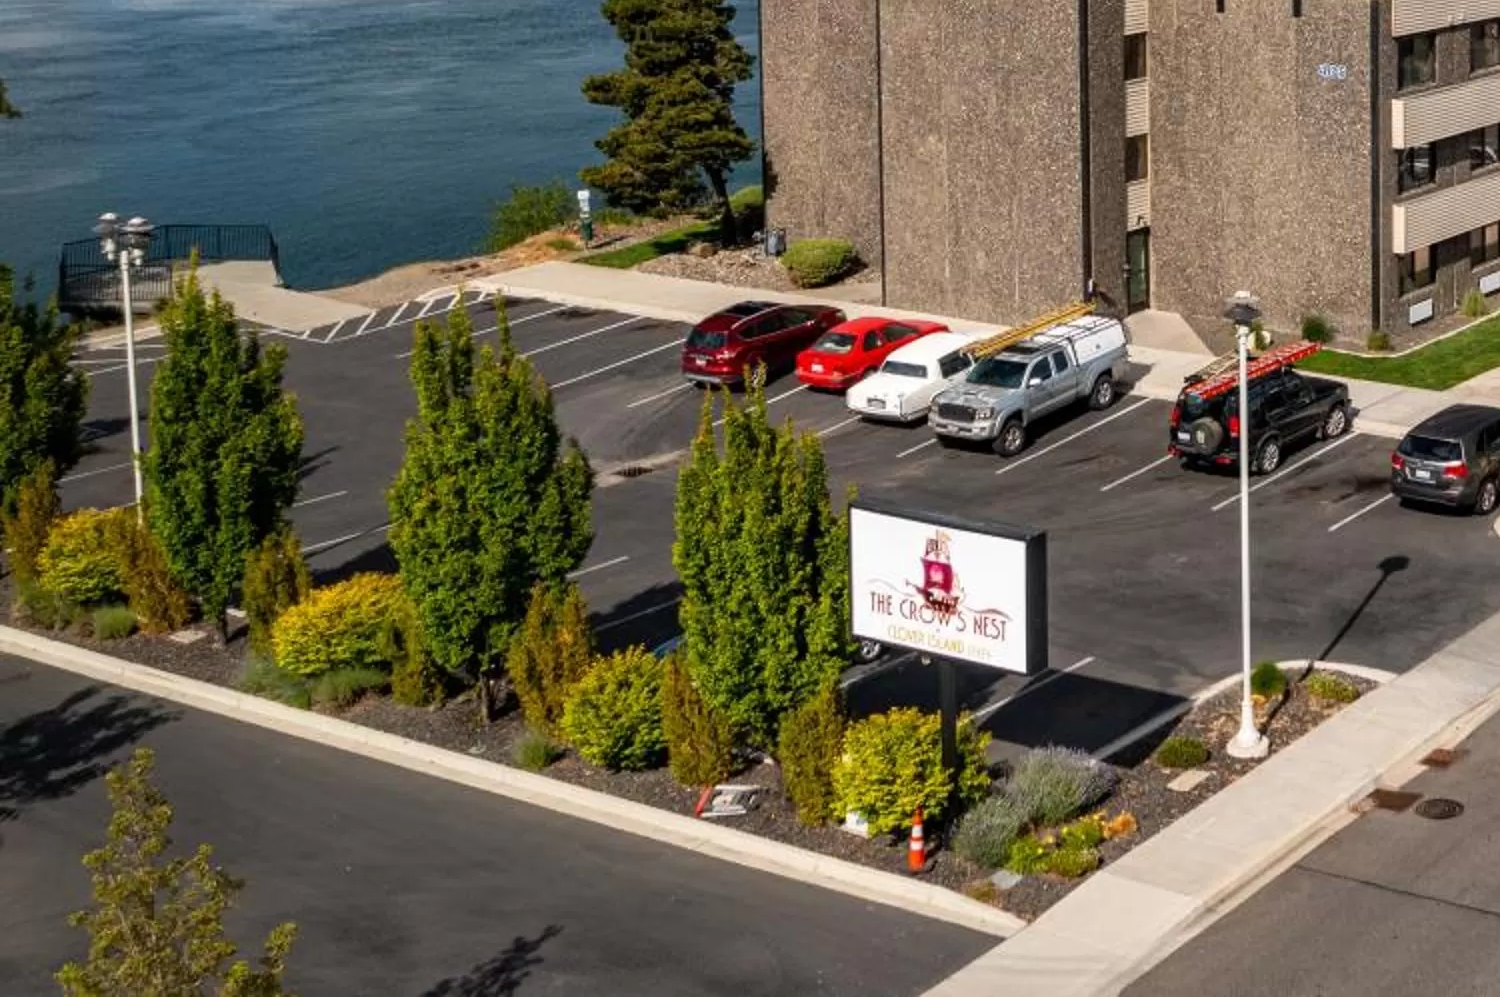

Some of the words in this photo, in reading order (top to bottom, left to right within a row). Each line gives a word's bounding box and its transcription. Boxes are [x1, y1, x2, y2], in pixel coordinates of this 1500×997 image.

[870, 591, 893, 616] THE
[900, 598, 967, 633] CROWS
[973, 615, 1007, 641] NEST
